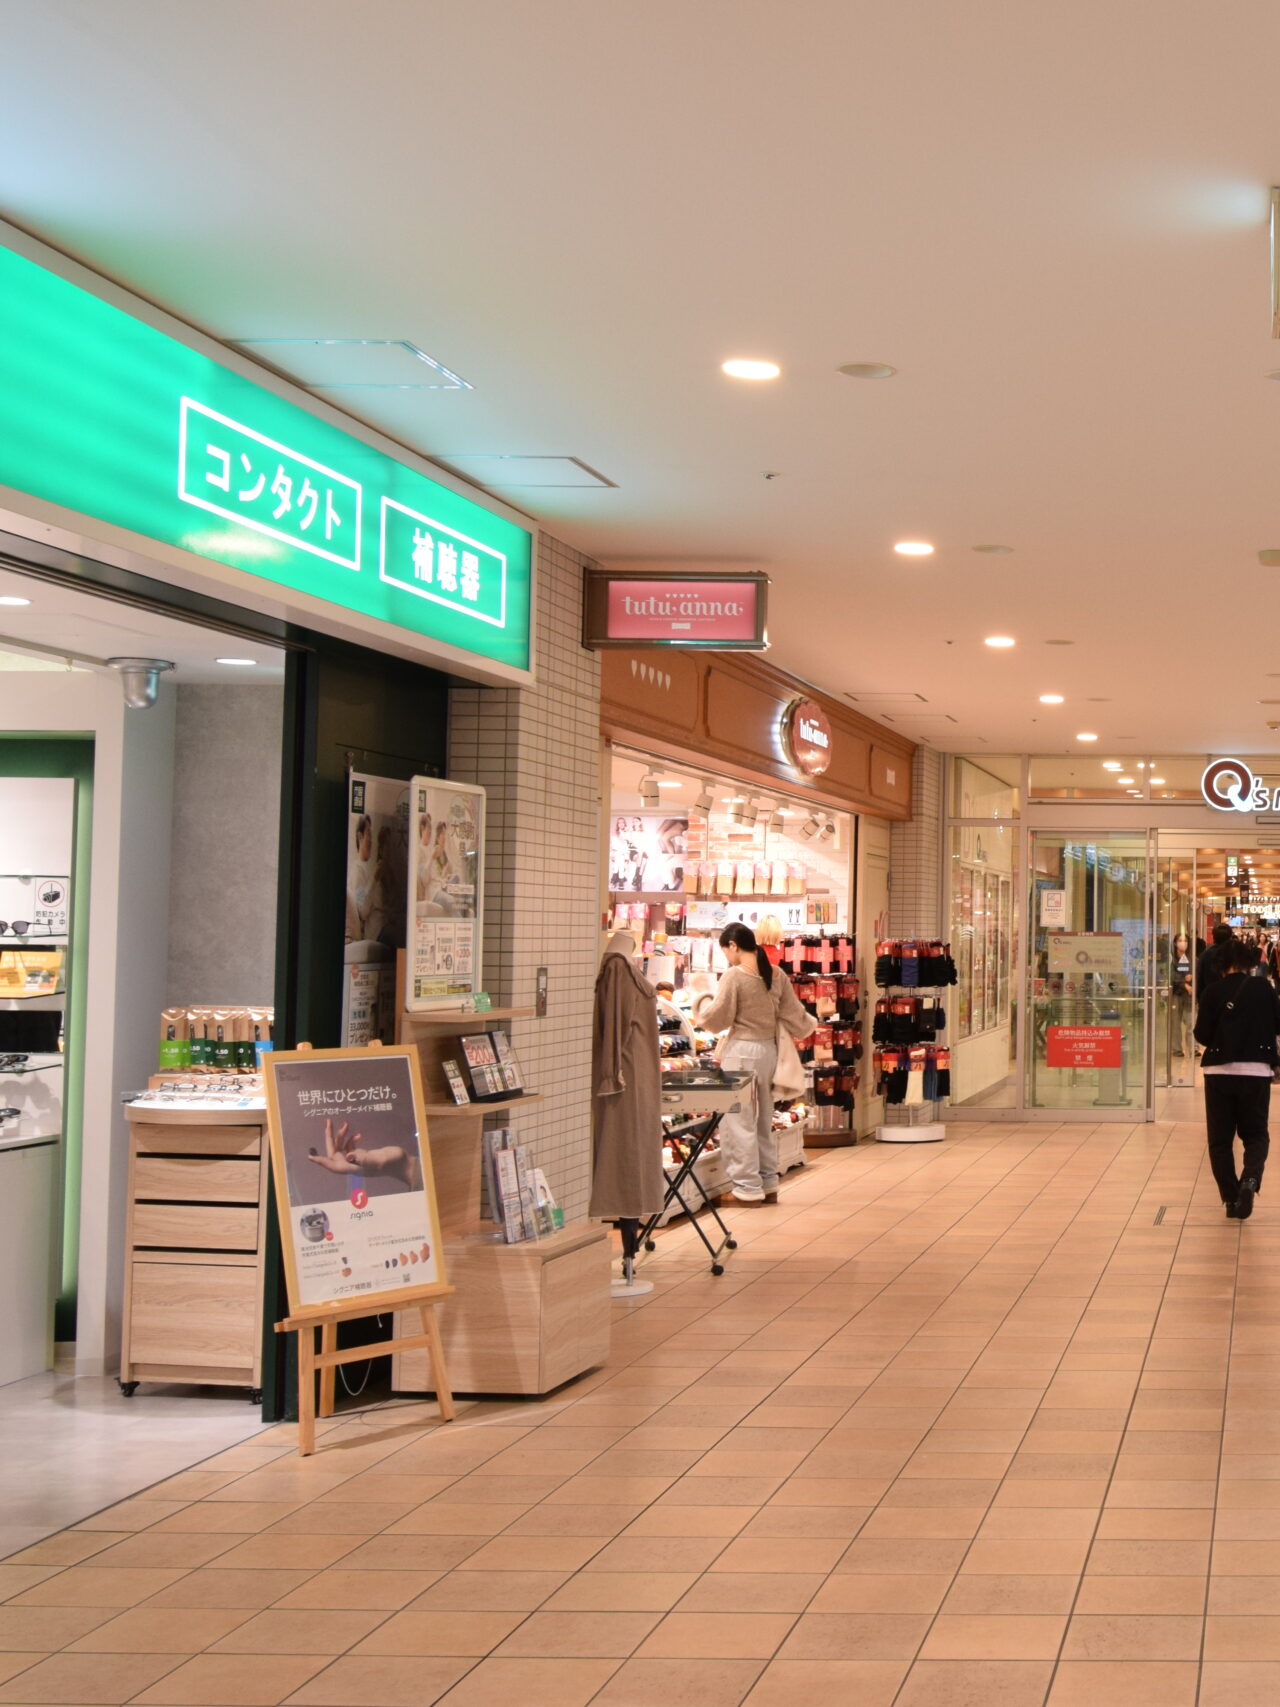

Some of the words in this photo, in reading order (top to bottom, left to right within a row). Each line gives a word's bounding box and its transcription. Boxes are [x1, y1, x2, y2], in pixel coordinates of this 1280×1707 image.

[205, 443, 341, 541] コンタクト
[411, 527, 481, 602] 補聴器
[621, 596, 671, 616] tutu
[679, 601, 739, 616] anna
[297, 1085, 398, 1105] 世界にひとつだけ。
[304, 1103, 392, 1117] シグニアのオーダーメイド補聴器
